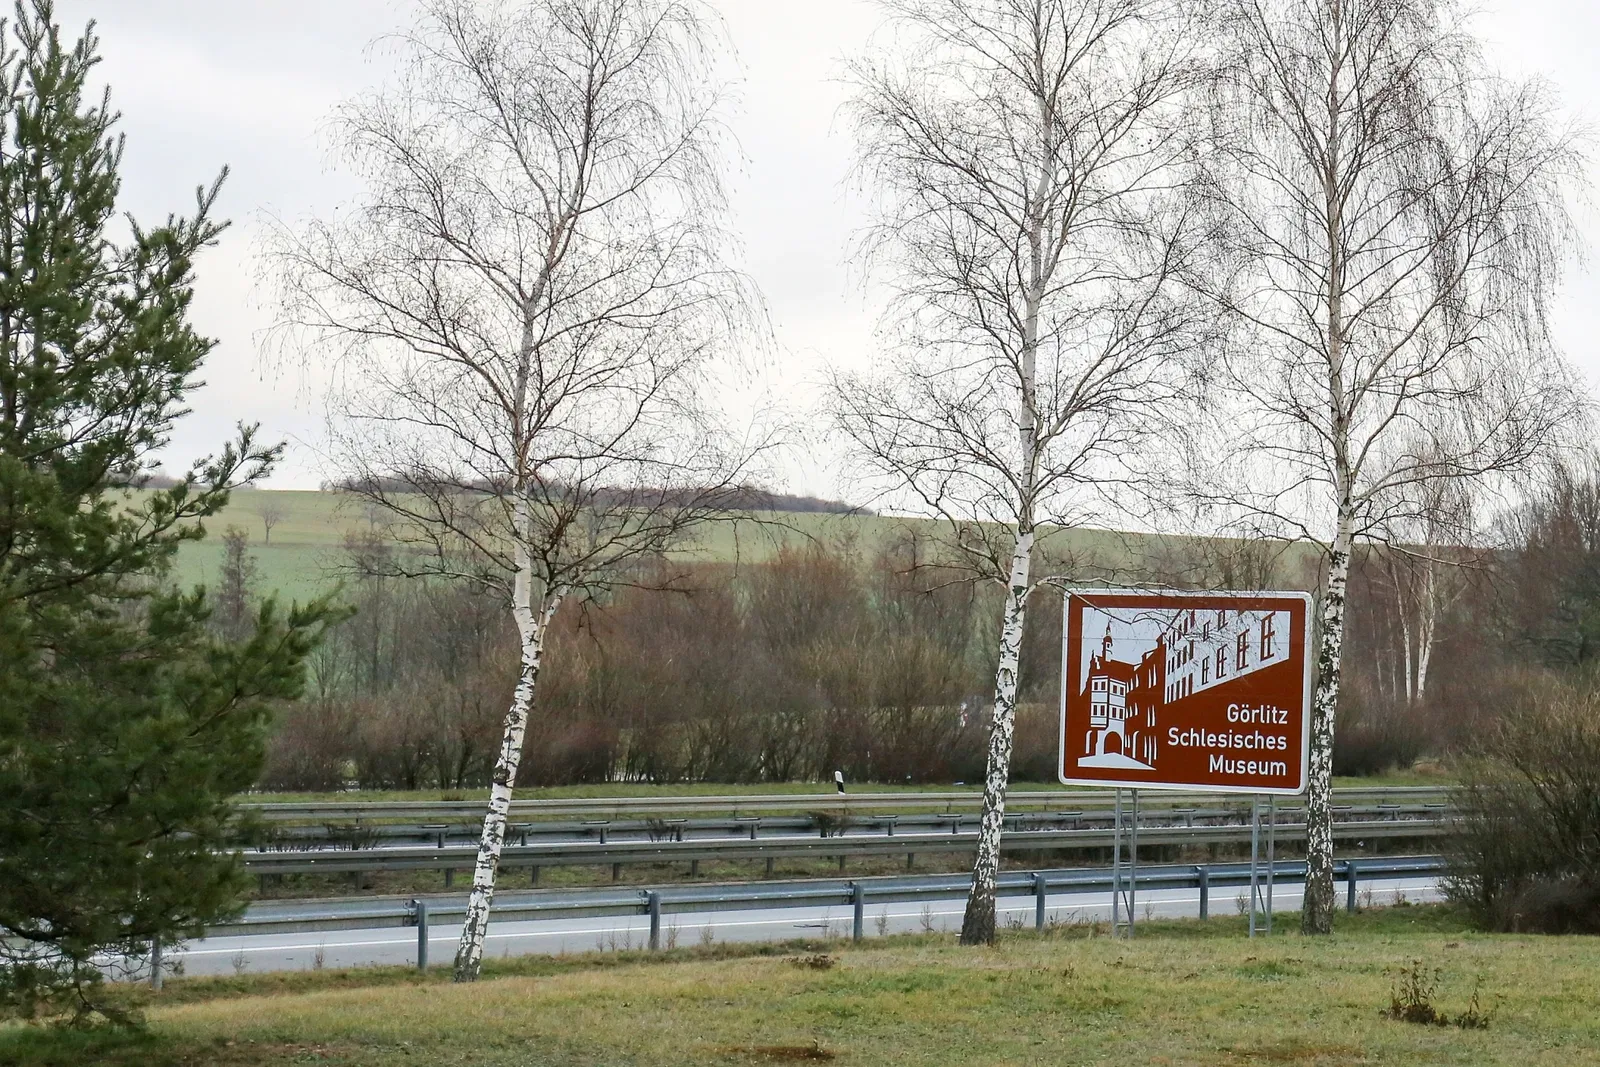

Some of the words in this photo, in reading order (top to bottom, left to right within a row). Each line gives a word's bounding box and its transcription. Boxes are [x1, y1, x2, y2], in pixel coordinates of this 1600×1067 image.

[1227, 703, 1288, 724] Görlitz
[1167, 727, 1287, 750] Schlesisches
[1209, 754, 1287, 776] Museum
